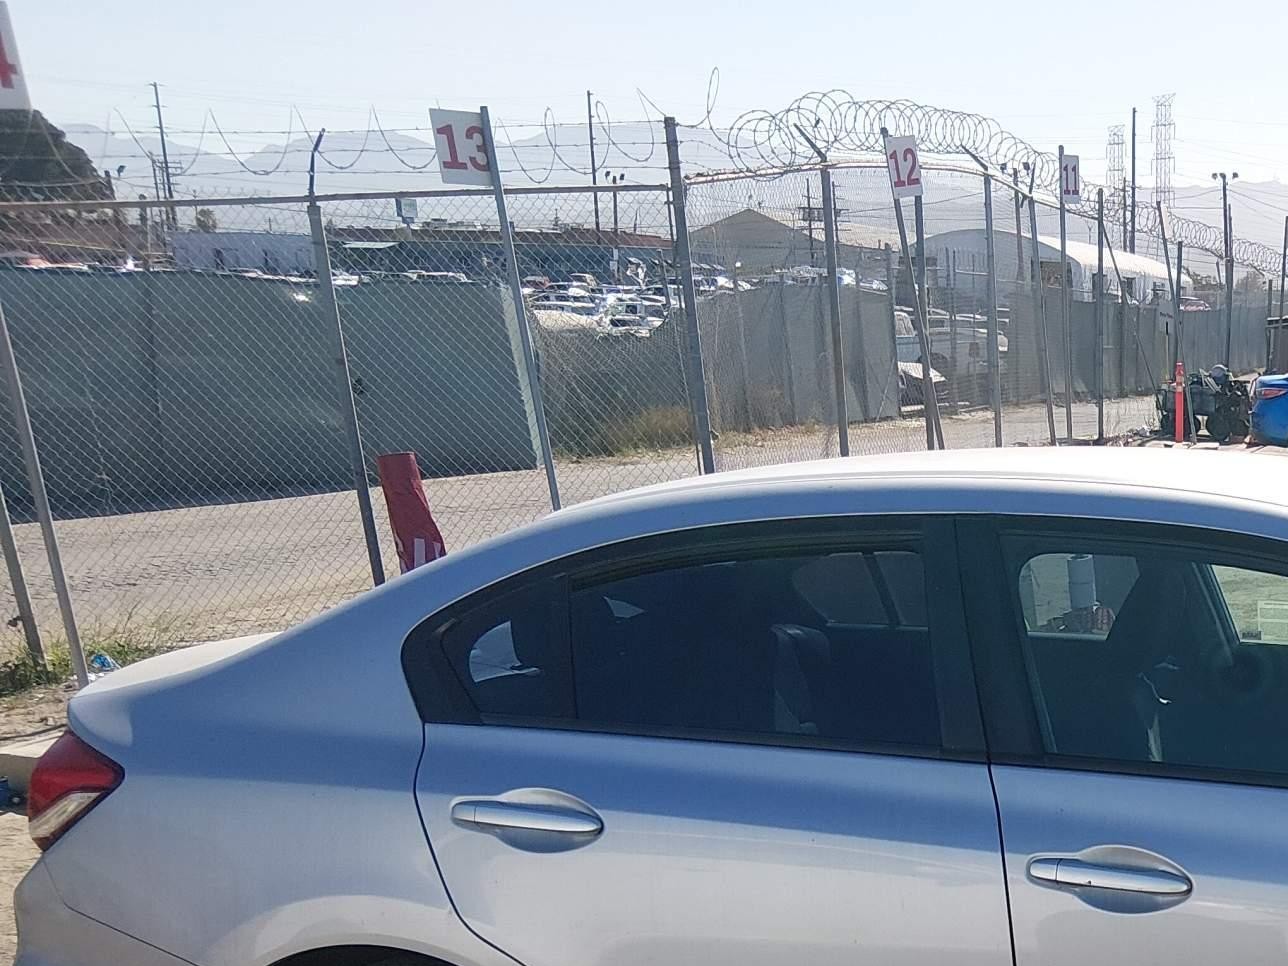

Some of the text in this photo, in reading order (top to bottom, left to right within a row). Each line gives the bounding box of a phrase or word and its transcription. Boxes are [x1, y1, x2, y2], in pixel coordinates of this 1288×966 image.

[436, 124, 490, 171] 13
[889, 147, 920, 187] 12
[1063, 163, 1080, 195] 11
